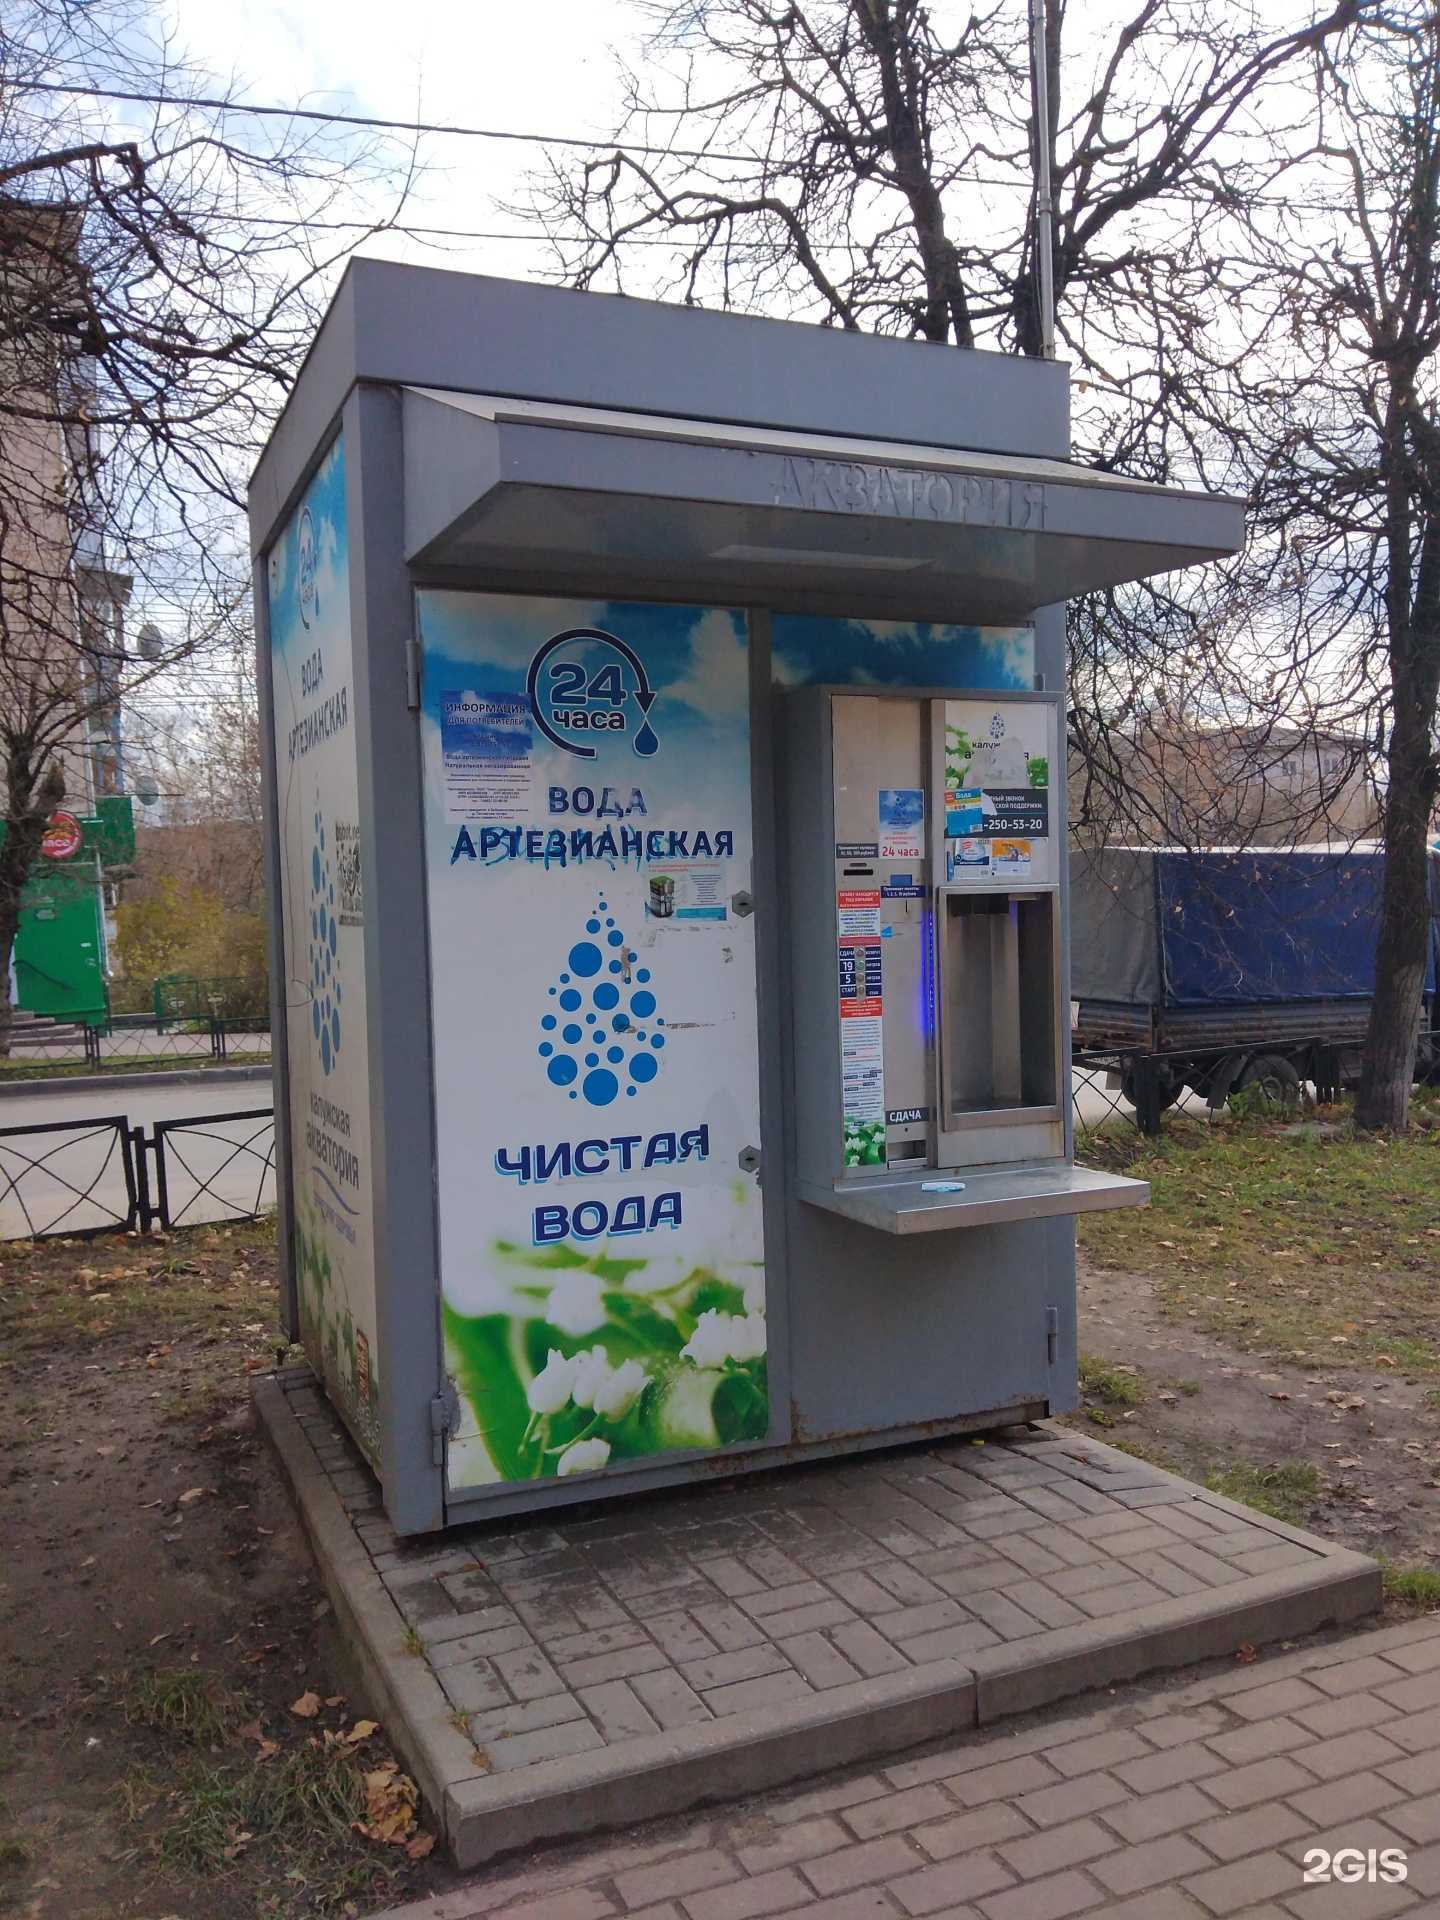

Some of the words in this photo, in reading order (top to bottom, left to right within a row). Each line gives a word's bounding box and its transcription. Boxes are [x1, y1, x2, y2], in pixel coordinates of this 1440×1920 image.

[771, 457, 1046, 528] АКВАТОРИЯ
[302, 648, 323, 697] ВОДА
[550, 663, 627, 706] 24
[446, 703, 525, 714] ИНФОРМАЦИЯ
[552, 710, 626, 731] часа
[289, 687, 348, 763] АРТЕЗИАНСКАЯ
[548, 786, 648, 818] ВОДА
[451, 830, 735, 861] АРТЕЗИАНСКАЯ
[882, 847, 895, 856] 24
[898, 848, 920, 857] часа
[843, 961, 853, 971] 19
[845, 974, 851, 984] 5
[889, 1110, 922, 1123] СДАЧА
[306, 1121, 359, 1190] акватория
[495, 1124, 710, 1185] ЧИСТАЯ
[532, 1192, 682, 1246] ВОДА
